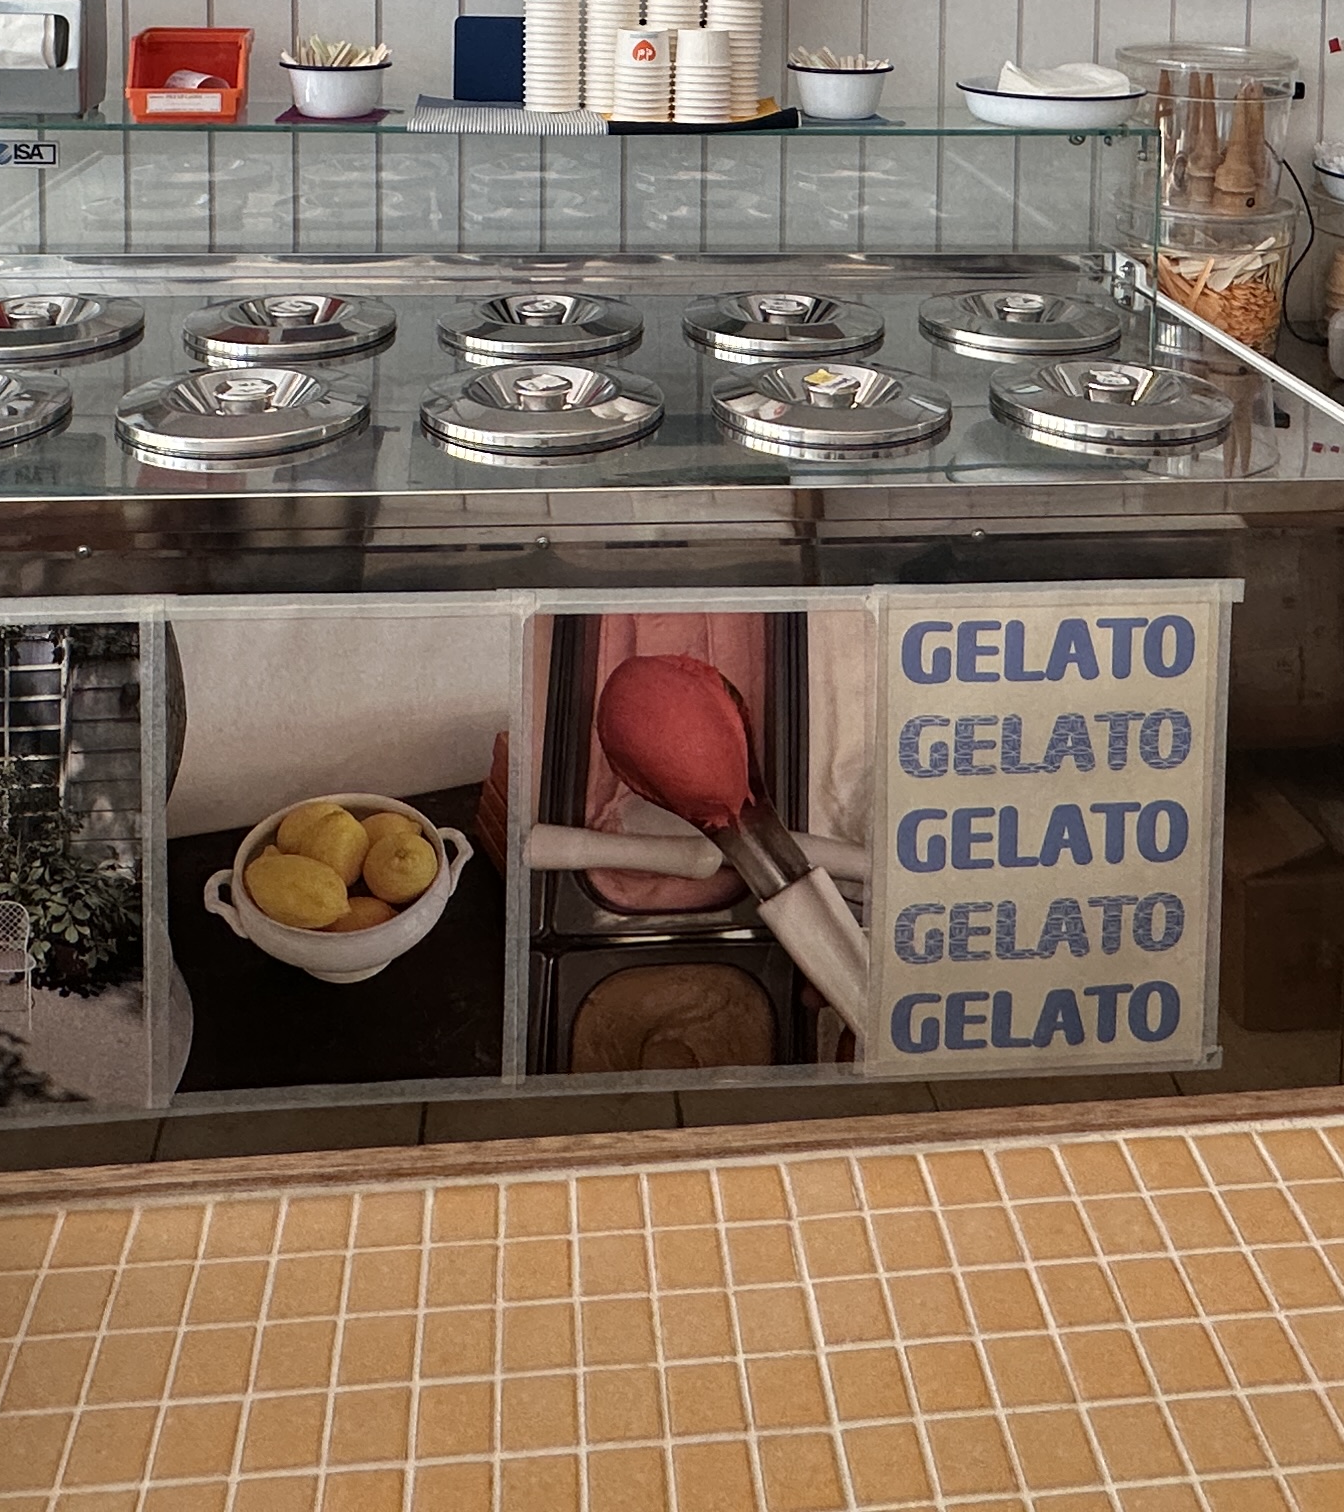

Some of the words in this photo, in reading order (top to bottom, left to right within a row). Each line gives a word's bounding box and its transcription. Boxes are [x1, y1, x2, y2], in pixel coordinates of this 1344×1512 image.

[13, 143, 44, 160] ISA
[901, 615, 1196, 685] GELATO
[898, 708, 1193, 778] GELATO
[896, 799, 1190, 873] GELATO
[893, 892, 1186, 964] GELATO
[890, 980, 1182, 1054] GELATO
